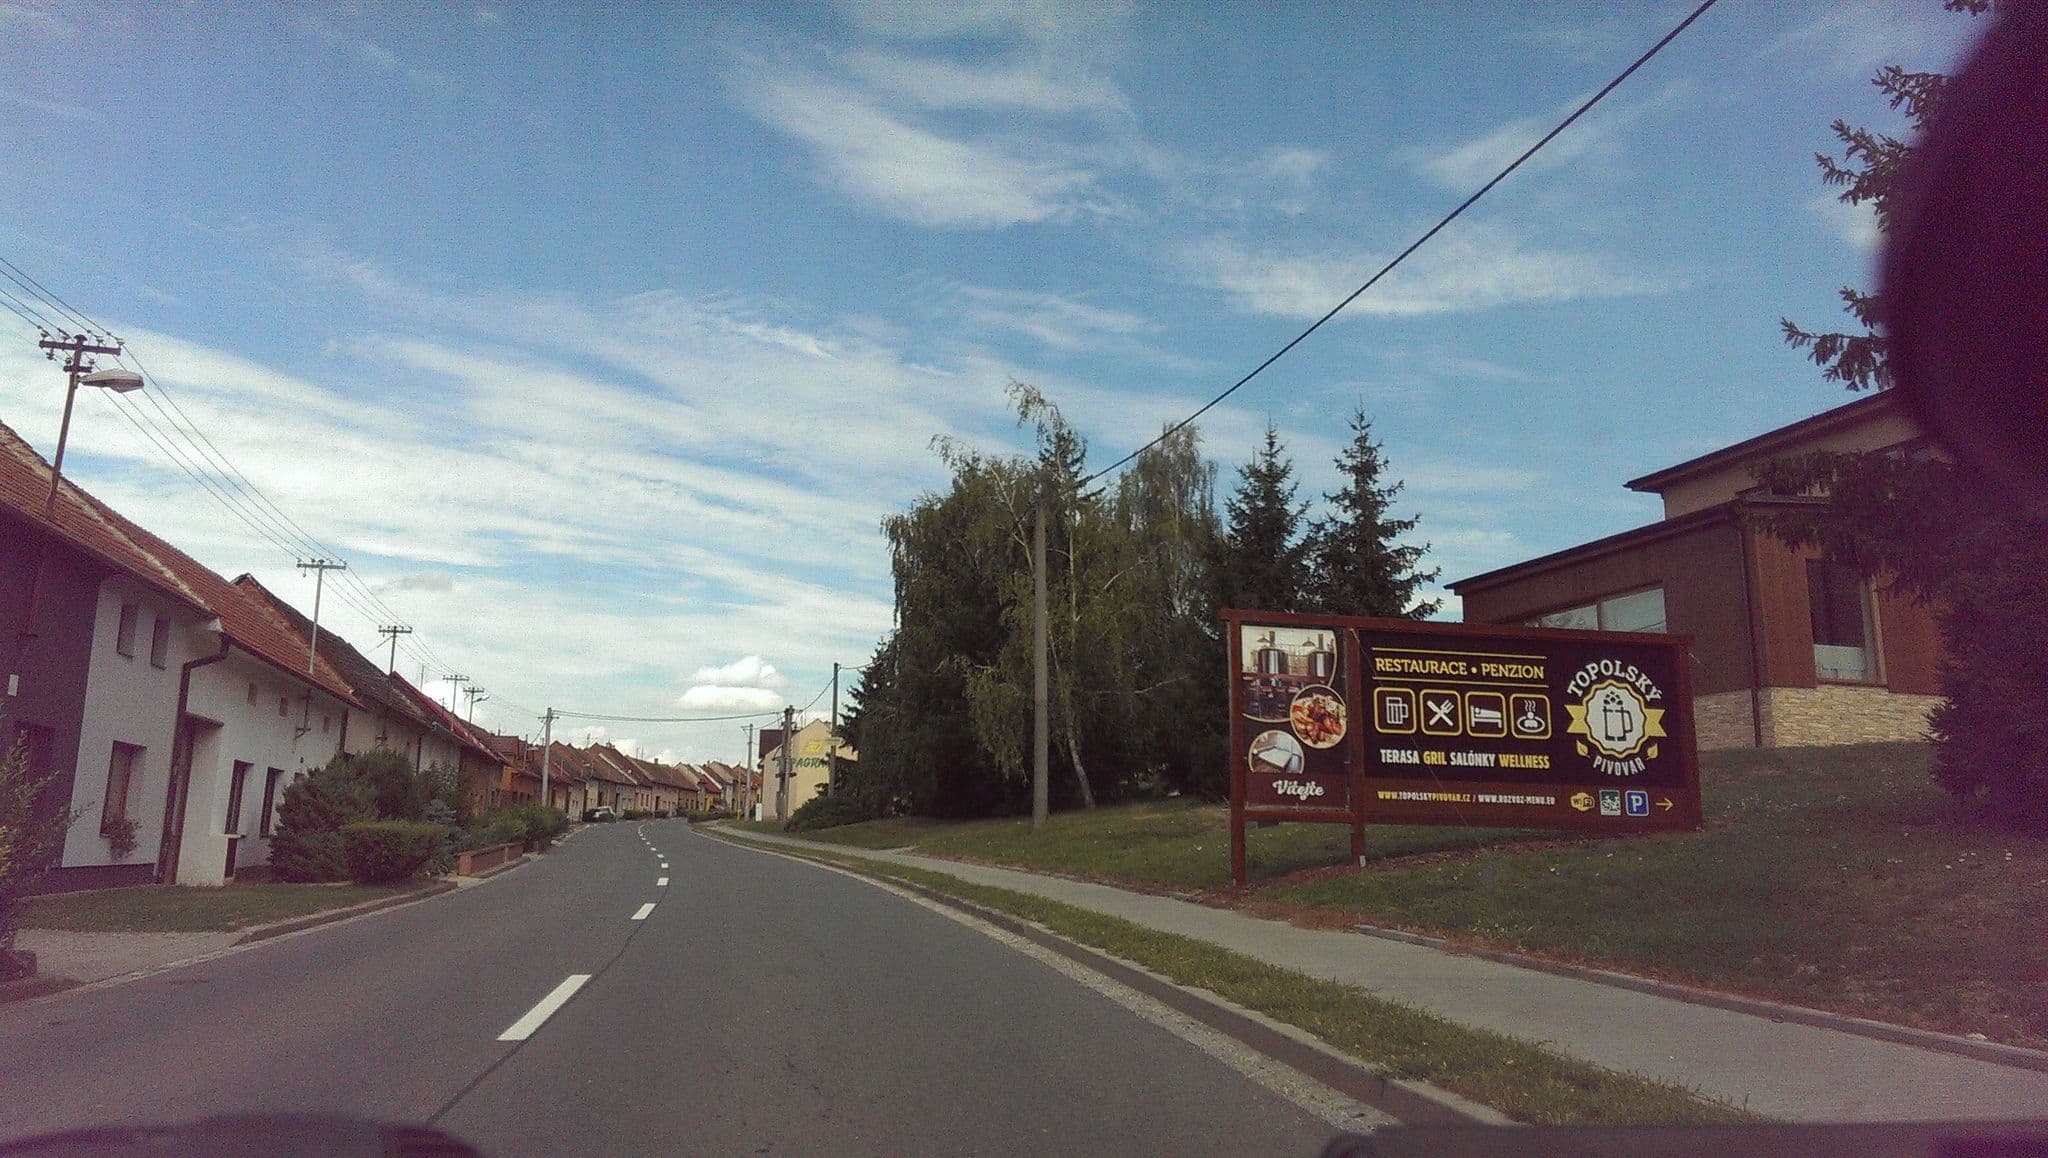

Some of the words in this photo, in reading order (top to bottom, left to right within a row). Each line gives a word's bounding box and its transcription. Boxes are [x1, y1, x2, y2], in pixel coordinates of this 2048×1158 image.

[1375, 657, 1468, 676] RESTAURACE
[1481, 663, 1545, 679] PENZION
[1380, 749, 1420, 764] TERASA
[1423, 751, 1448, 765] GRIL
[1449, 750, 1496, 767] SALÓNKY
[1499, 753, 1551, 769] WELLNESS
[1593, 756, 1646, 776] PIVOVAR
[1630, 794, 1644, 812] P
